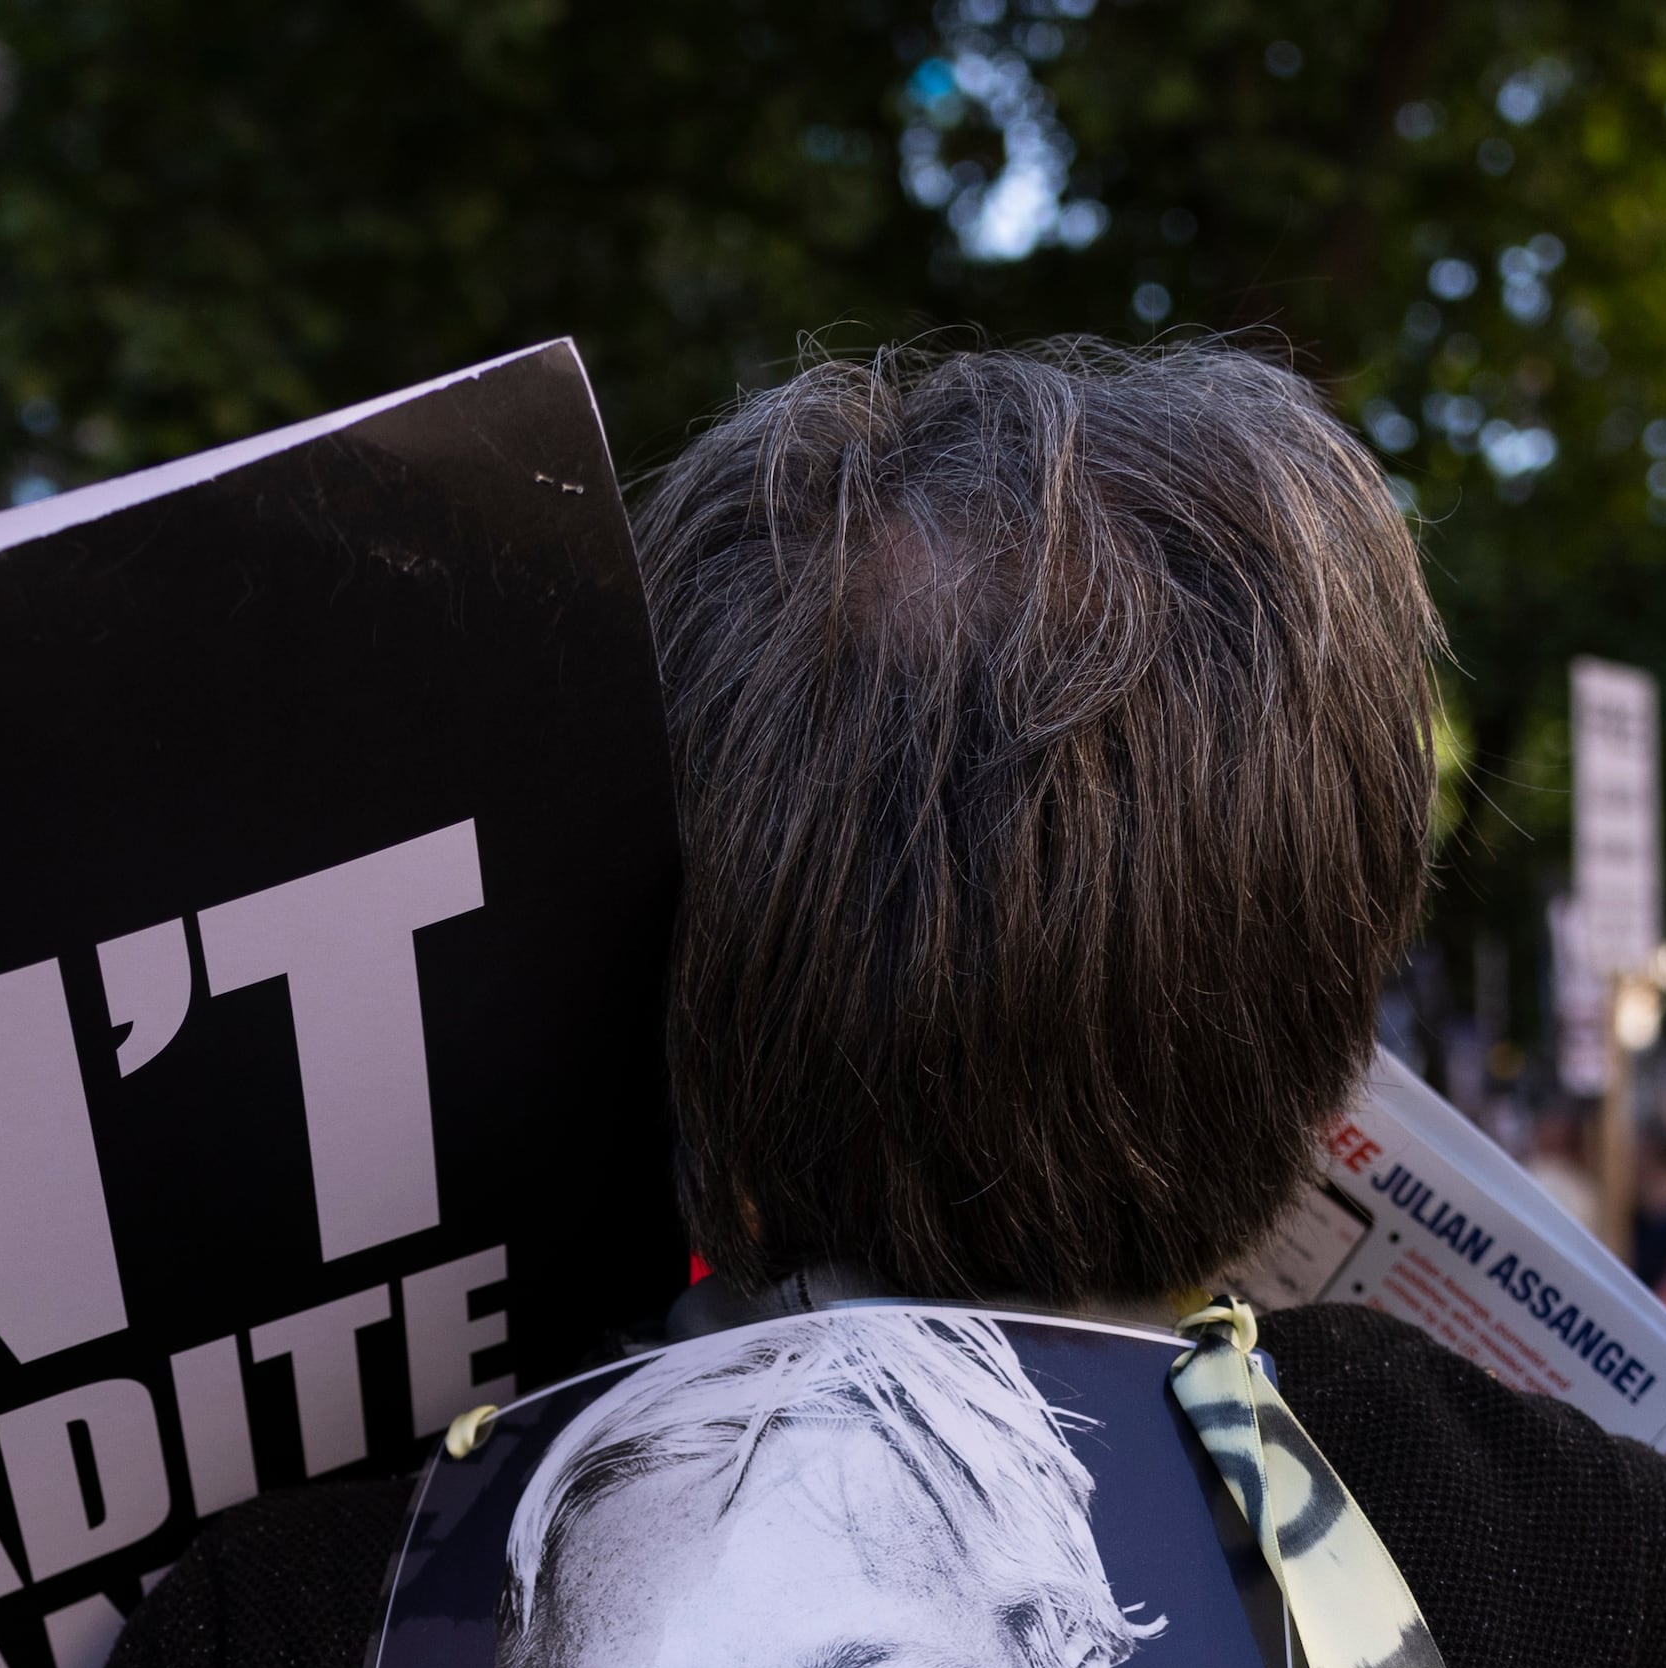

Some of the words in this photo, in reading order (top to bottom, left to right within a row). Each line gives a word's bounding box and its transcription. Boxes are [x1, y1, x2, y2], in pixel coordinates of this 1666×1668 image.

[1319, 1113, 1382, 1174] EE
[1370, 1164, 1495, 1266] JULIAN
[1487, 1253, 1657, 1405] ASSANGE!
